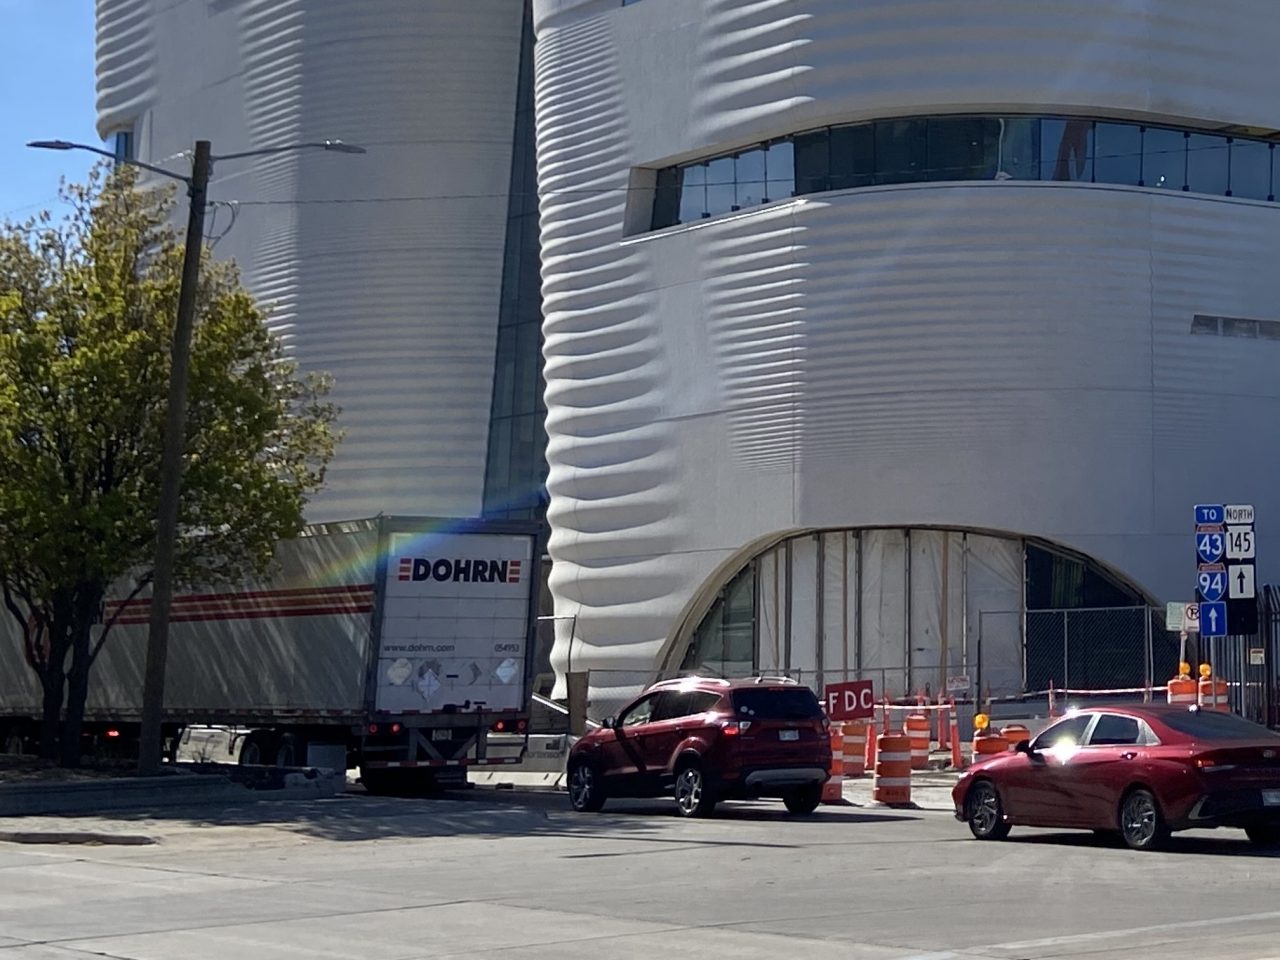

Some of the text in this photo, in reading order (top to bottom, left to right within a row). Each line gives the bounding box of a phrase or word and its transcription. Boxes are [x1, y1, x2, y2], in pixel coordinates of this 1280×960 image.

[1201, 509, 1218, 521] TO
[1226, 508, 1253, 521] NORTH
[1199, 534, 1223, 555] 43
[1229, 532, 1251, 553] 145
[411, 558, 509, 583] DOHRN
[1200, 573, 1223, 594] 94
